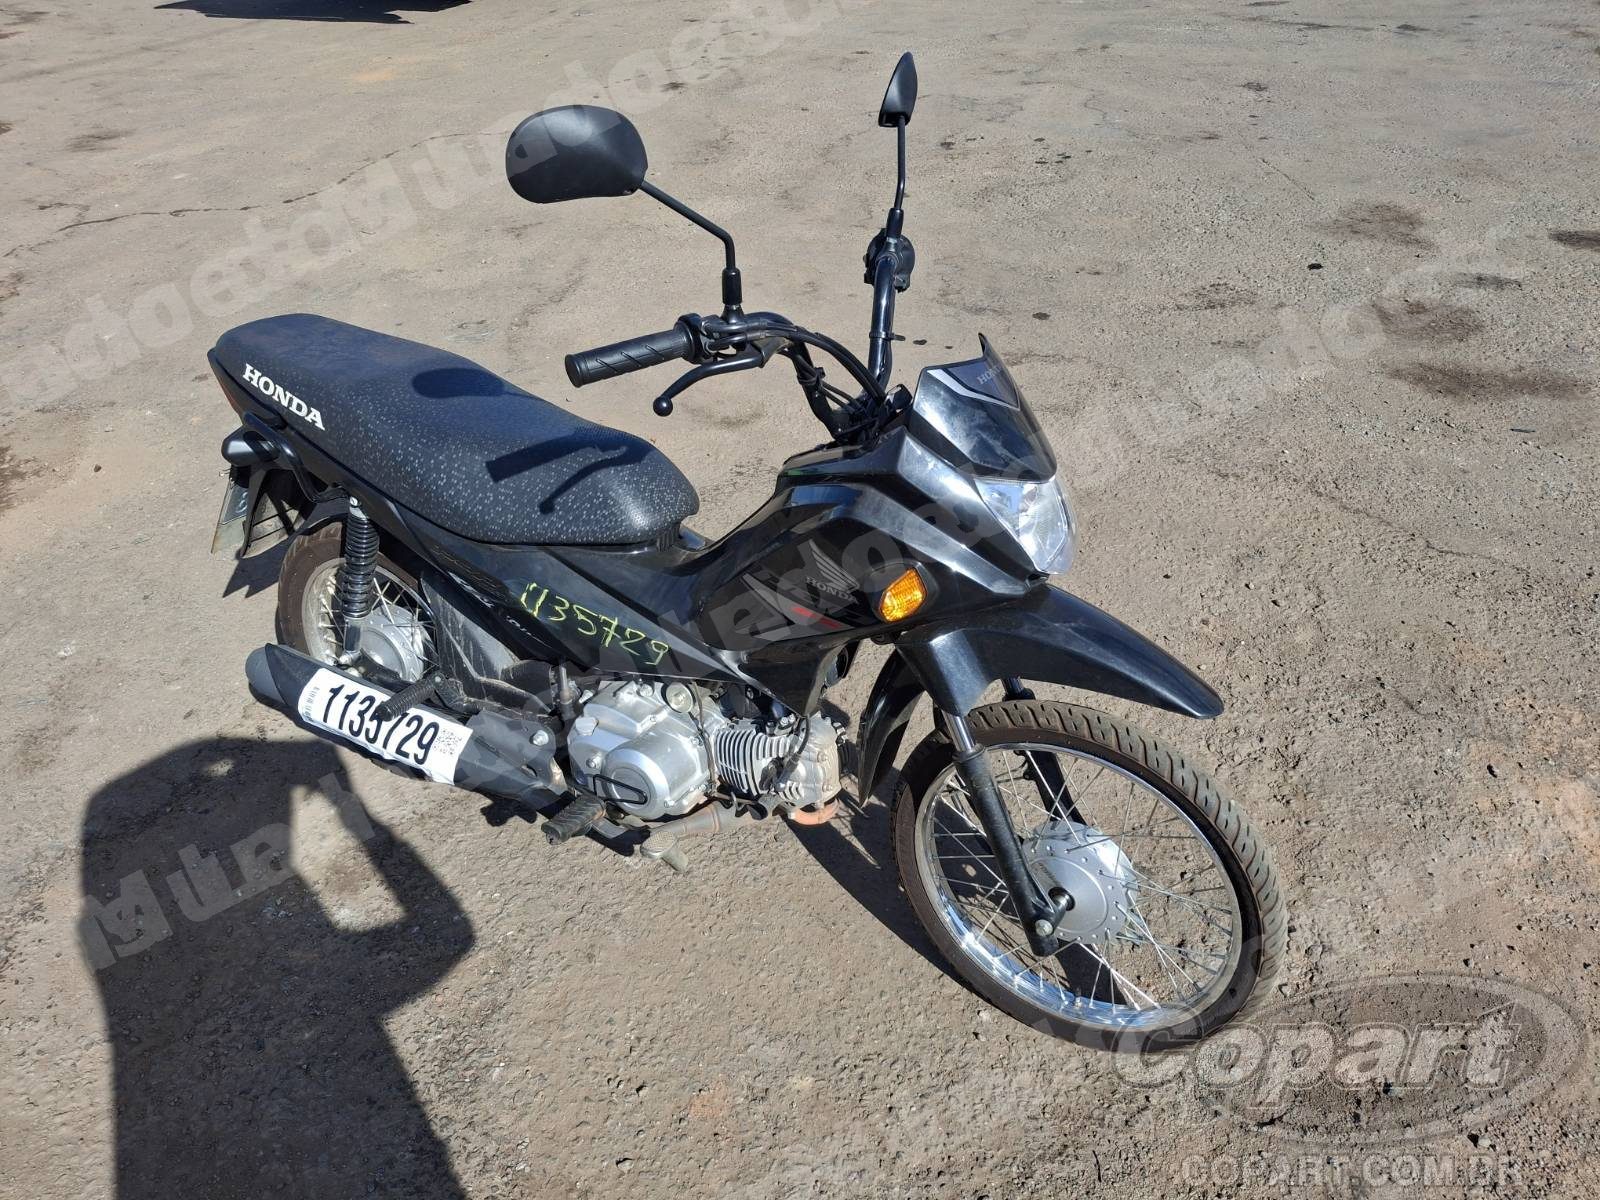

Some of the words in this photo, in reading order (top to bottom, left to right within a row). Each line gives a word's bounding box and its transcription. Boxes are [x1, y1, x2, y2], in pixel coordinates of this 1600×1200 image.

[976, 365, 1002, 385] HON
[242, 362, 326, 431] HONDA
[806, 576, 859, 604] HONDA
